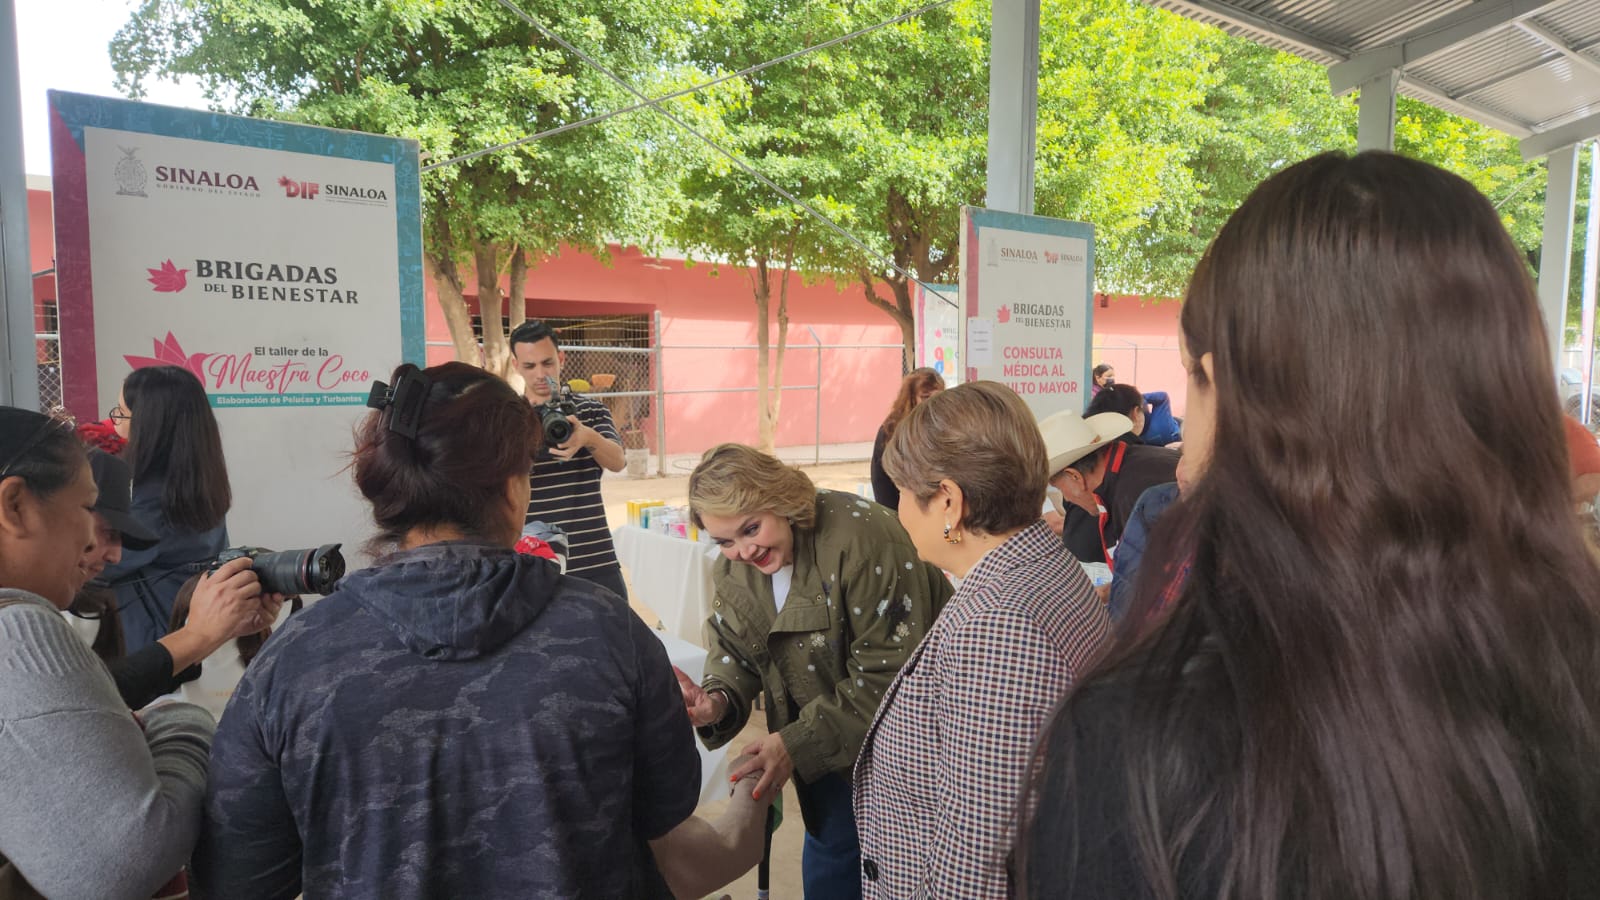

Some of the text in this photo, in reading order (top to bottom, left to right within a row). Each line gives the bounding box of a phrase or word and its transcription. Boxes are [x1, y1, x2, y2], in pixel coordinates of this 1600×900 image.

[155, 165, 259, 191] SINALOA
[285, 180, 387, 200] DIF SINALOA
[1000, 247, 1038, 260] SINALOA
[196, 259, 338, 285] BRIGADAS
[204, 283, 359, 304] DEL BIENESTAR
[1013, 303, 1065, 316] BRIGADAS
[1024, 317, 1071, 329] BIENESTAR
[254, 346, 329, 357] El taller de la
[1003, 346, 1063, 359] CONSULTA
[208, 352, 370, 395] Maestra Coco
[1003, 360, 1065, 377] MÉDICA AL
[1039, 381, 1078, 394] MAYOR
[217, 395, 362, 405] Elaboración de Pelucas y Turbantes
